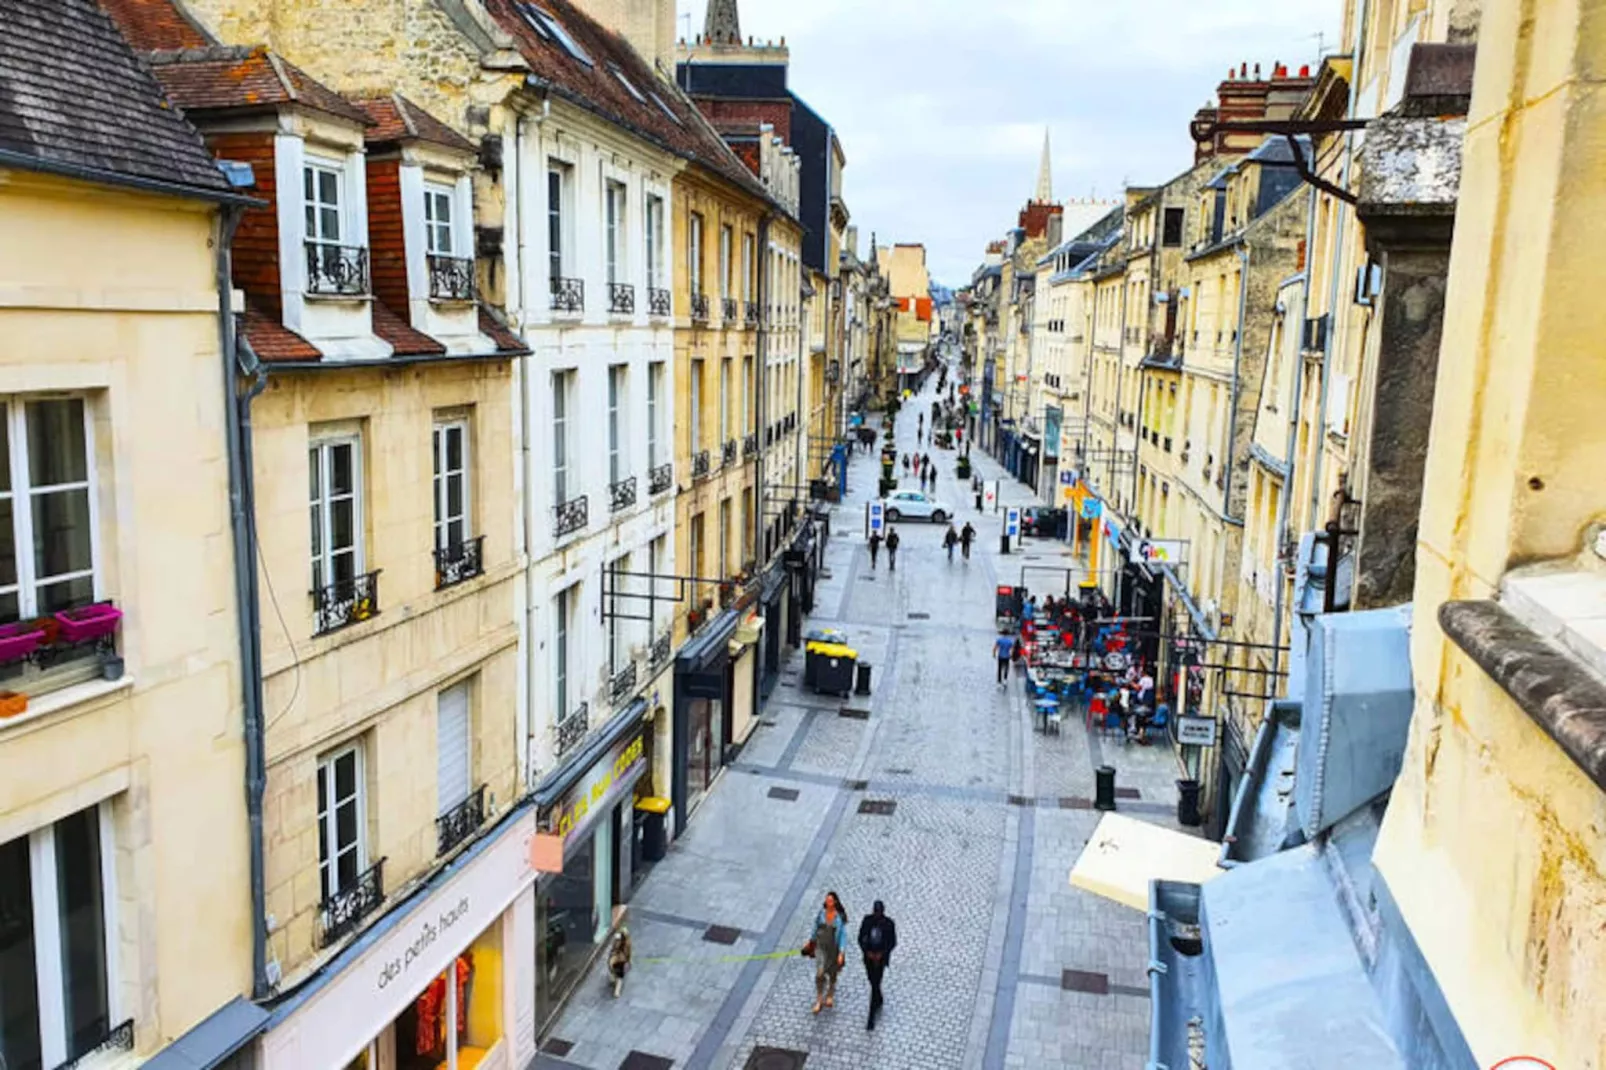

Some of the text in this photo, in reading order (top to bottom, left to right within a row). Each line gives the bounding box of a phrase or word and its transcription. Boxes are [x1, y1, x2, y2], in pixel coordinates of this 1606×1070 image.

[377, 896, 469, 989] des petits hauts
